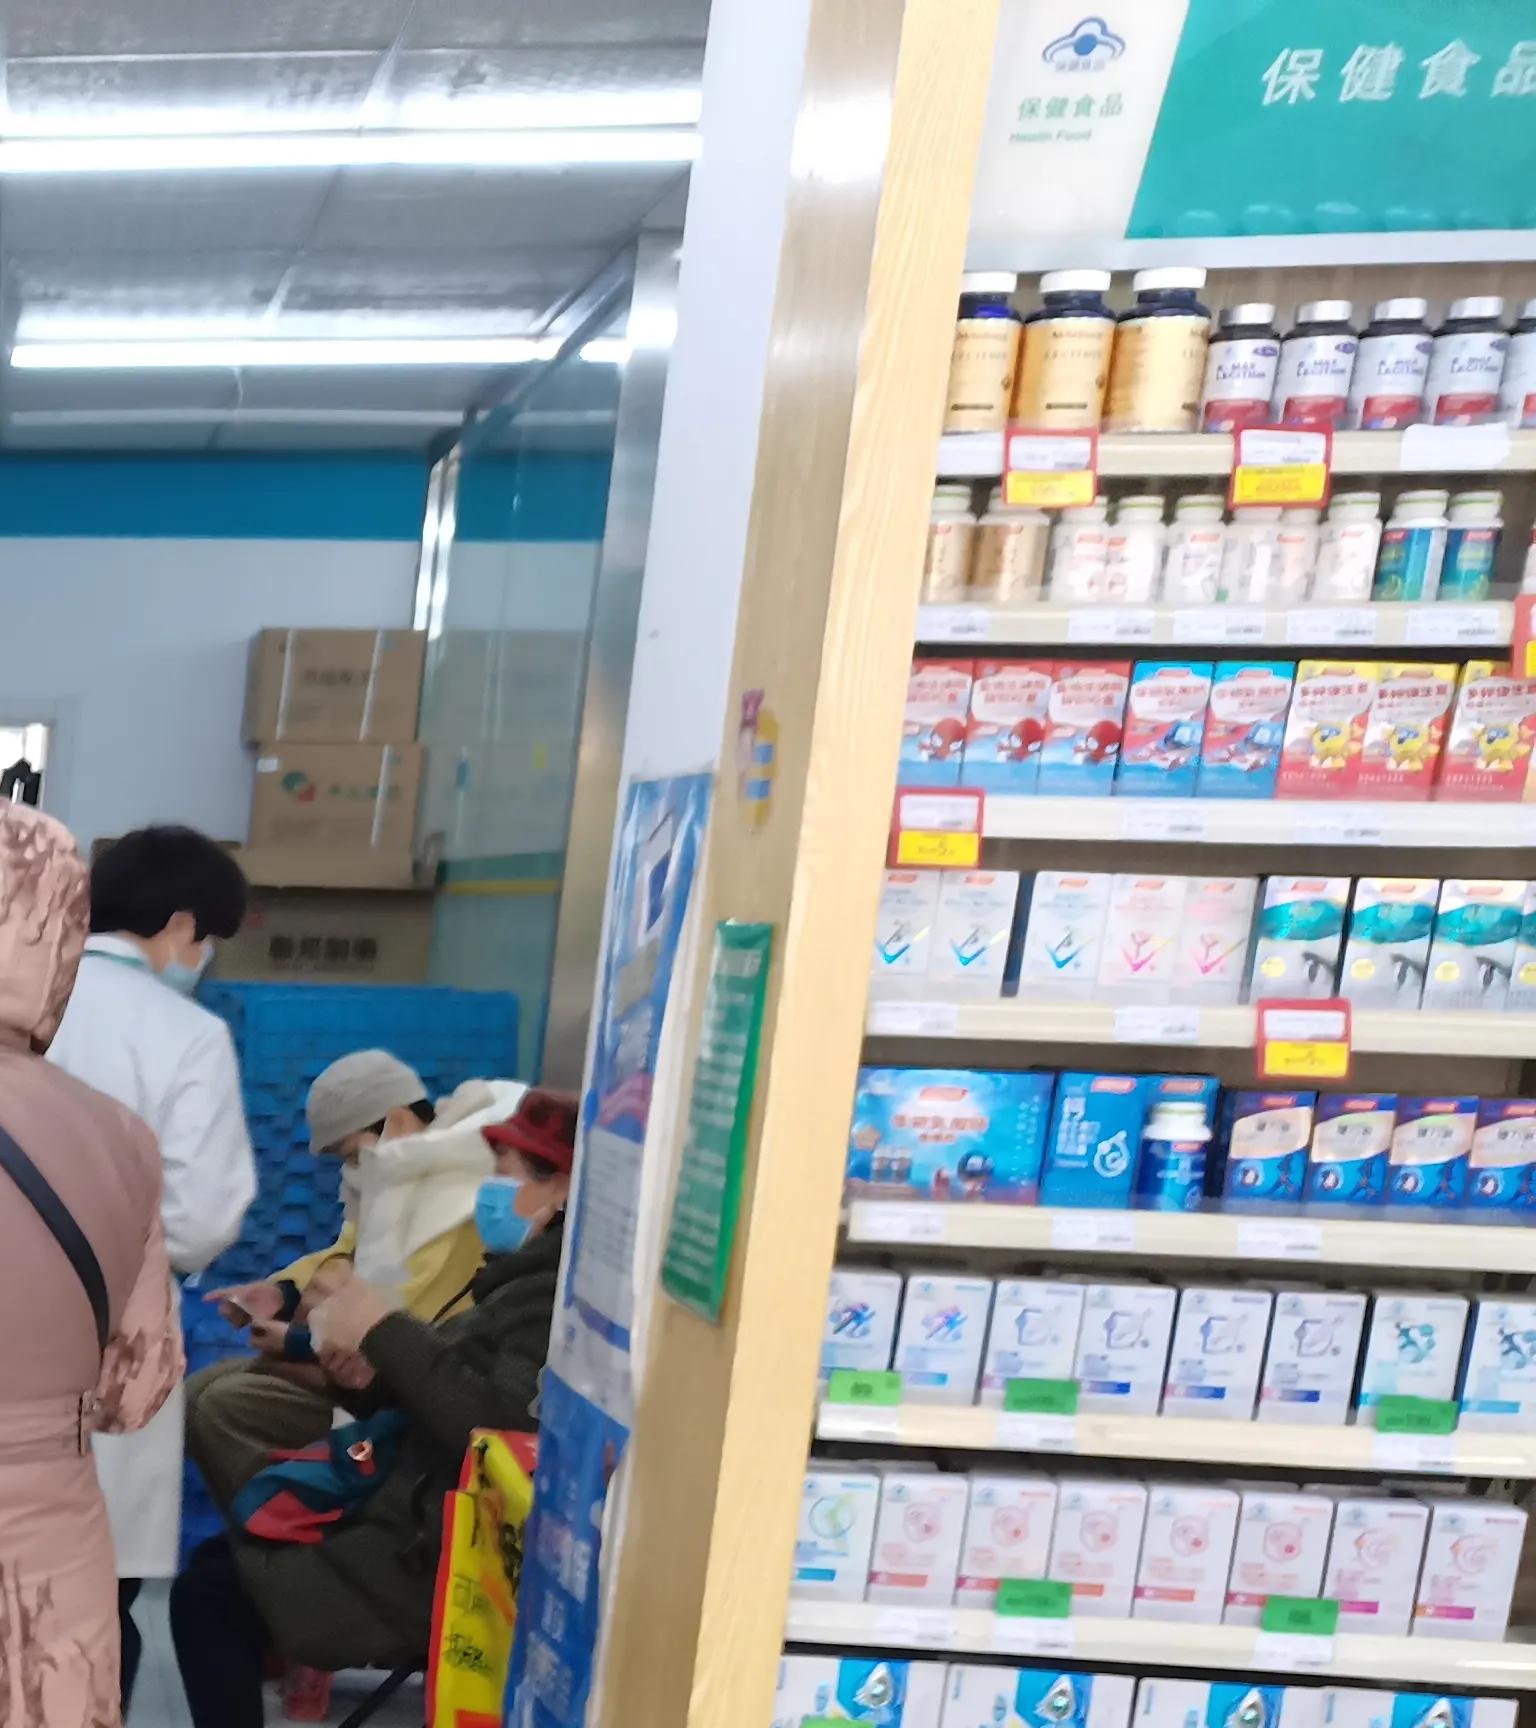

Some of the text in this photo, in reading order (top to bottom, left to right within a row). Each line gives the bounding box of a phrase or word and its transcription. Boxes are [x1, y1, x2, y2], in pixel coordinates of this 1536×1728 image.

[1262, 38, 1536, 106] 保健食品
[1018, 93, 1124, 121] 保健食品
